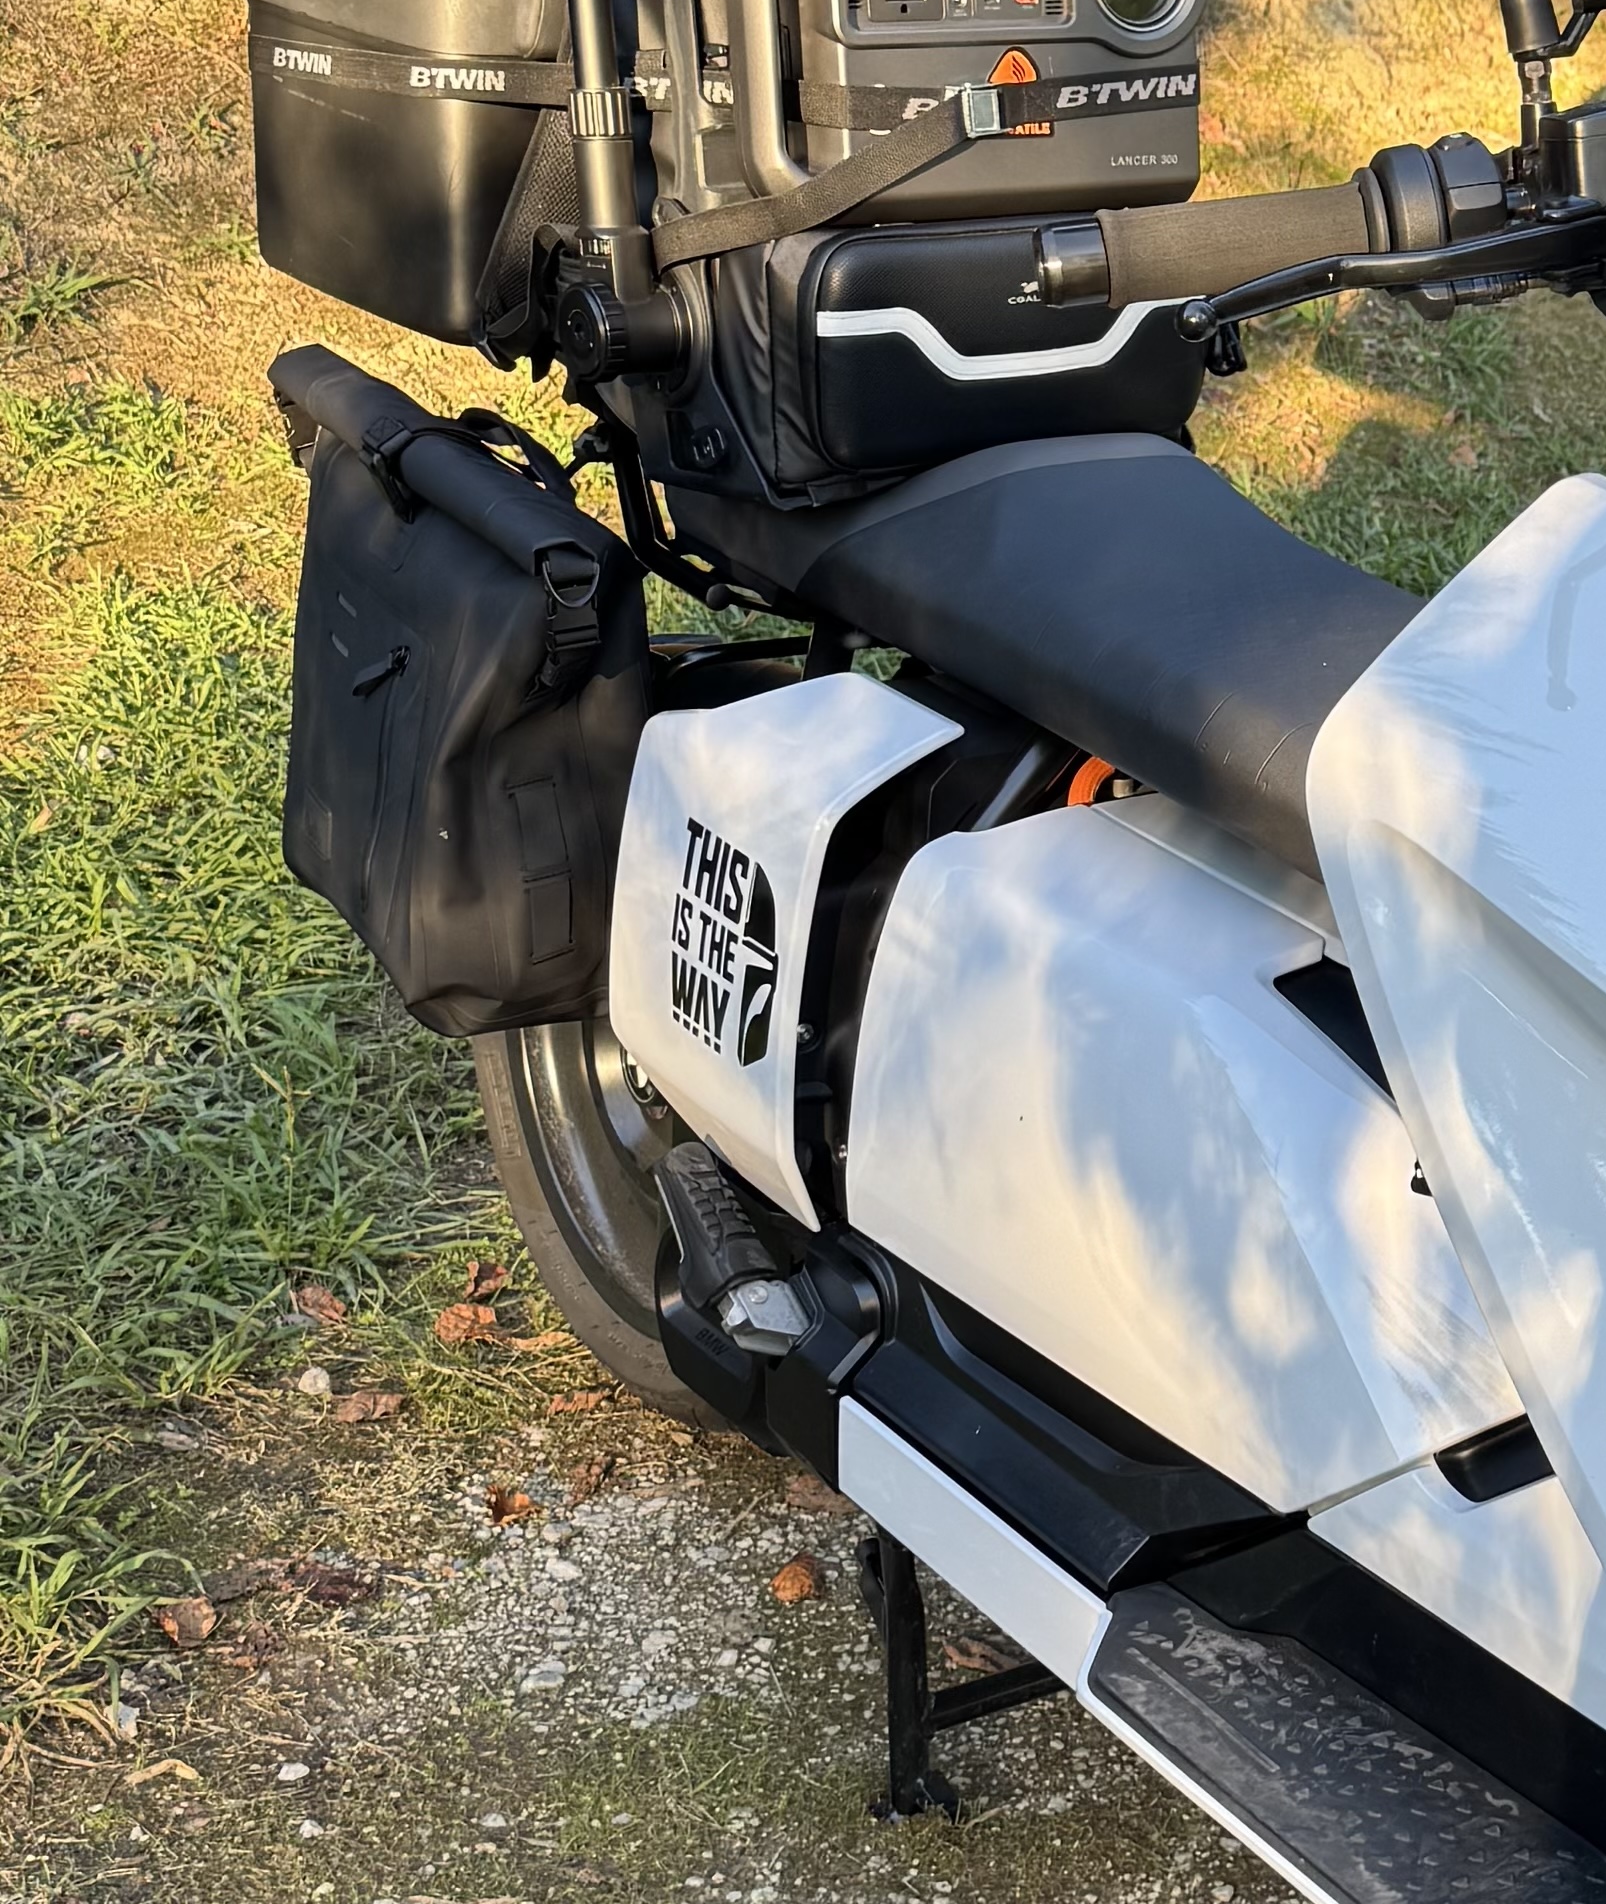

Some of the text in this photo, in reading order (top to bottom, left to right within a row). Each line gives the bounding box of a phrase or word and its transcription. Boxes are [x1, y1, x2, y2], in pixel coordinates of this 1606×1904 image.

[1110, 154, 1179, 167] LANCER 300
[682, 816, 750, 925] THIS
[671, 893, 740, 985] IS THE
